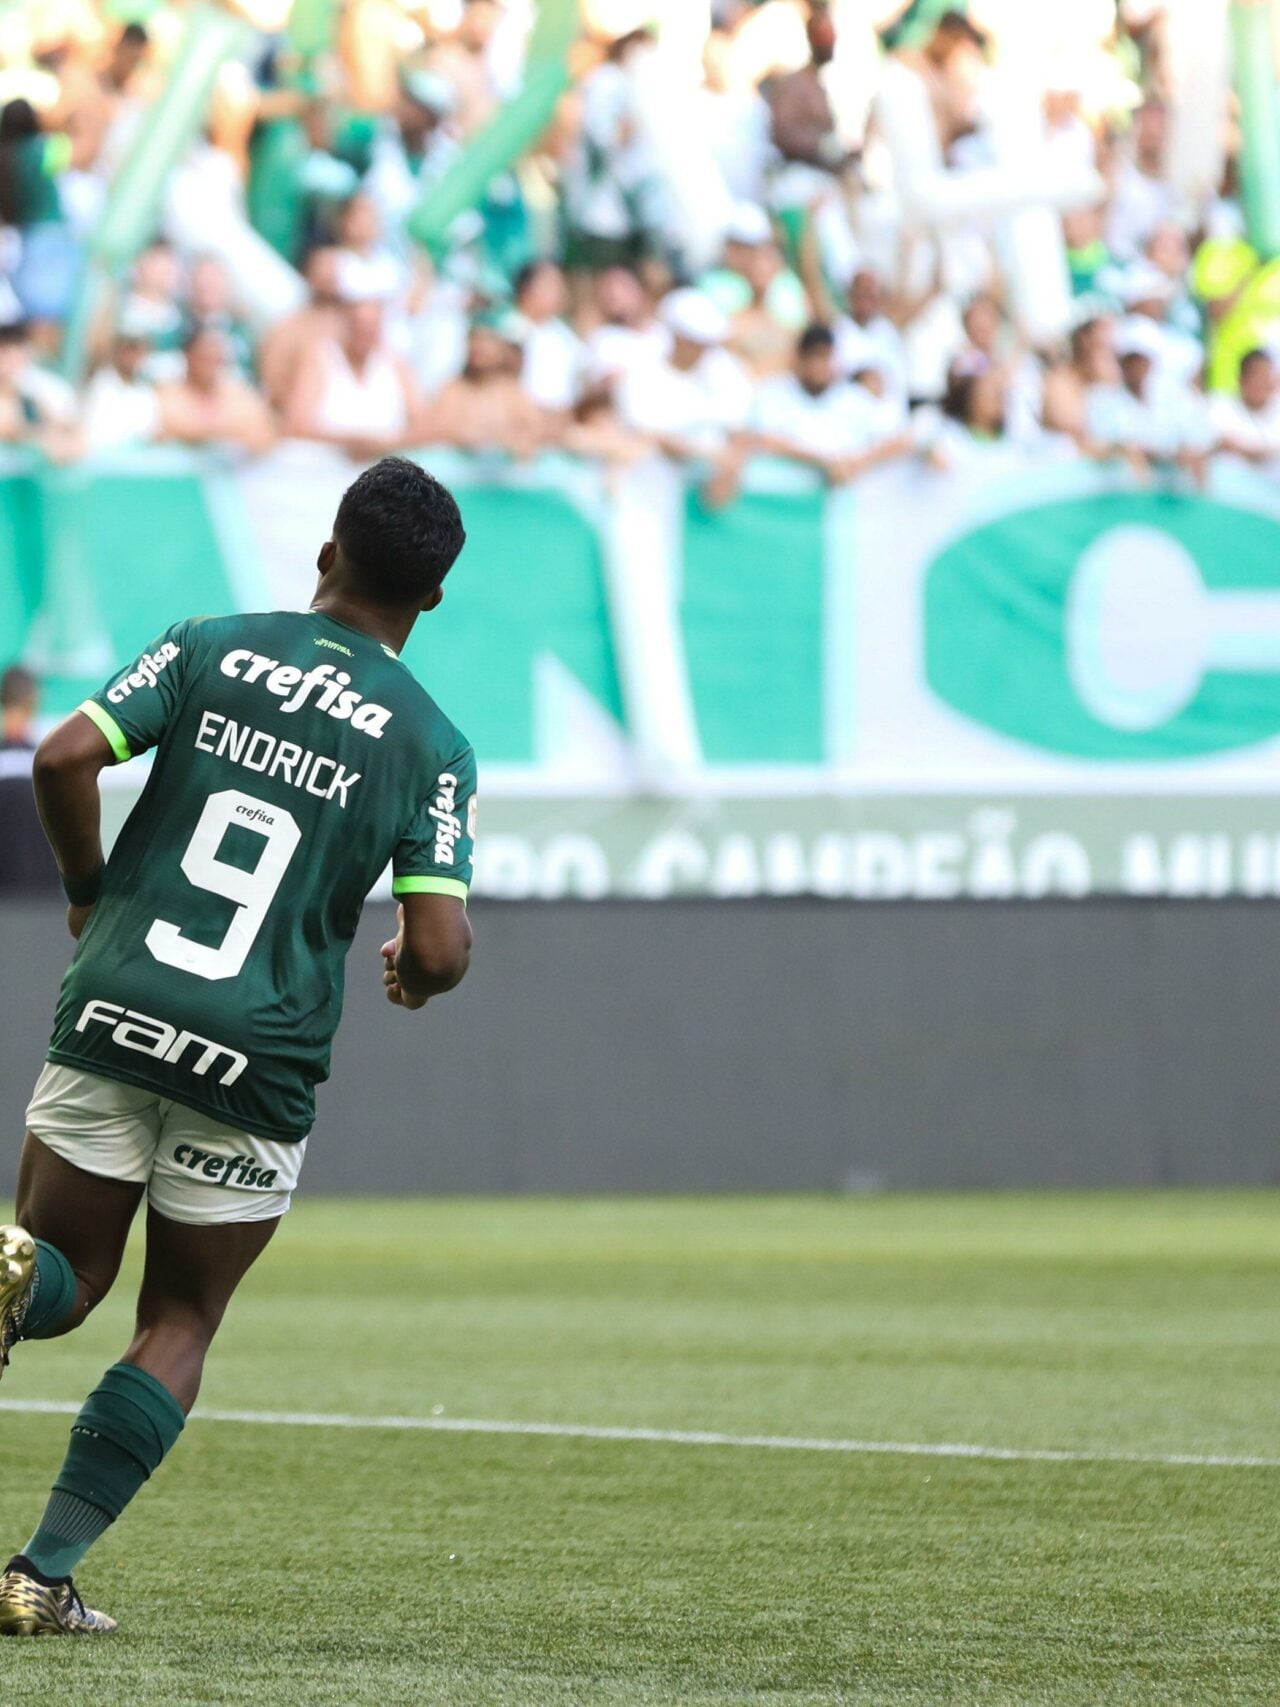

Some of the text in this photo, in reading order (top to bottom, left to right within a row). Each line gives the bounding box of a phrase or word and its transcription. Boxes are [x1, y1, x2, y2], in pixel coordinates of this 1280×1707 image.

[106, 641, 180, 703] crefisa
[220, 649, 393, 739] crefisa
[194, 710, 362, 809] ENDRICK
[235, 805, 275, 825] crefisa
[428, 772, 461, 865] crefisa
[144, 789, 302, 981] 9
[173, 1144, 278, 1188] crefisa
